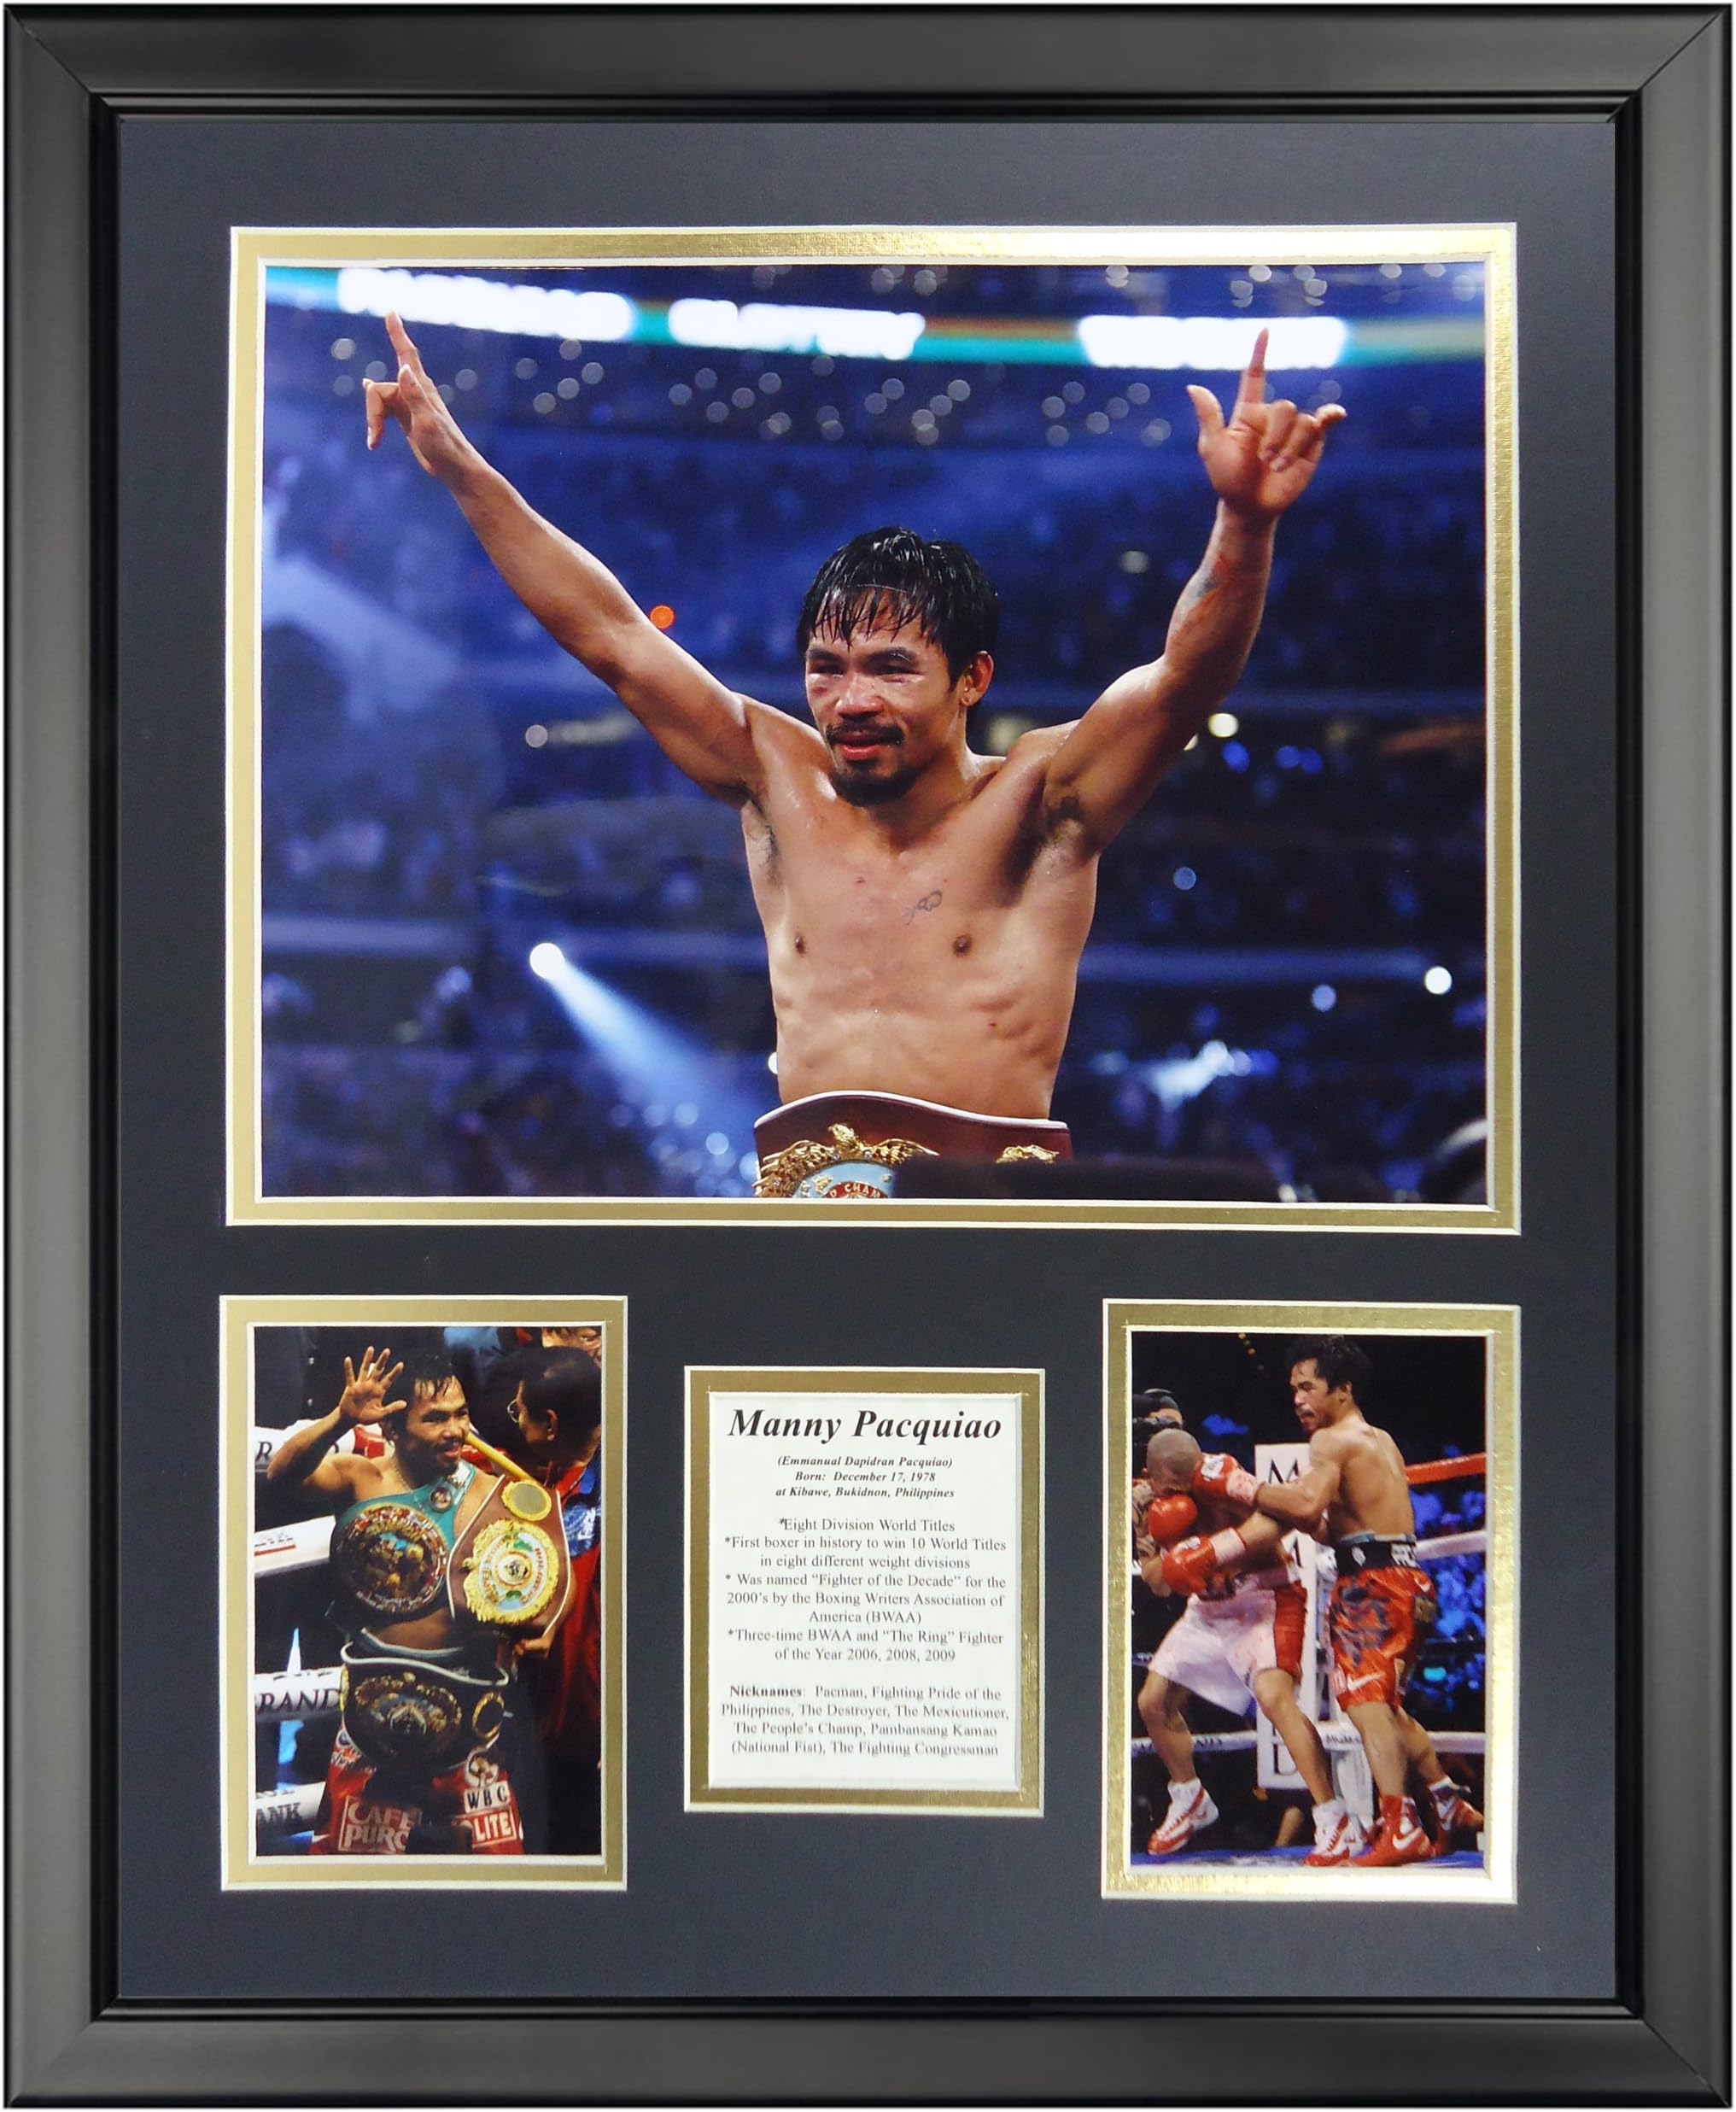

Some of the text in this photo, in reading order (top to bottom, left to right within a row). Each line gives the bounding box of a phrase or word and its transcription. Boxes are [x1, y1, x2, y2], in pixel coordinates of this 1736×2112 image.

[727, 1408, 1002, 1447] Manny Pacquiao
[777, 1455, 953, 1469] (Emmanual Dapidran Pacquiao)
[794, 1471, 936, 1483] Born: December 17, 1978
[788, 1486, 832, 1497] Kibawe,
[834, 1487, 891, 1497] Bukidnon,
[894, 1488, 956, 1500] Philippines
[821, 1518, 874, 1530] Division
[879, 1518, 916, 1530] World
[920, 1519, 956, 1531] Titles
[764, 1536, 800, 1547] boxer
[804, 1536, 815, 1548] in
[820, 1536, 862, 1551] history
[867, 1539, 879, 1548] to
[883, 1537, 906, 1548] win
[912, 1538, 926, 1549] 10
[930, 1537, 968, 1550] World
[971, 1539, 1007, 1550] Titles
[760, 1554, 971, 1571] in eight different weight divisions
[737, 1573, 763, 1585] Was
[766, 1573, 808, 1585] named
[867, 1574, 882, 1586] of
[884, 1574, 903, 1586] the
[965, 1576, 984, 1588] for
[987, 1577, 1006, 1588] the
[772, 1592, 788, 1606] by
[792, 1592, 811, 1603] the
[815, 1592, 861, 1606] Boxing
[865, 1593, 910, 1605] Writers
[913, 1594, 986, 1606] Association
[990, 1595, 1005, 1606] of
[809, 1611, 922, 1624] America (BWAA)
[808, 1629, 852, 1641] BWAA
[856, 1629, 879, 1641] and
[959, 1631, 1004, 1646] Fighter
[774, 1647, 956, 1662] of the Year 2006, 2008, 2009
[729, 1685, 1002, 1700] Nicknames: Pacman, Fighting Pride of the
[722, 1703, 1009, 1719] Philippines, The Destroyer, The Mexicutioner,
[733, 1722, 757, 1734] The
[817, 1722, 866, 1737] Champ,
[871, 1723, 949, 1737] Pambansang
[953, 1724, 997, 1736] Kamao
[731, 1740, 998, 1758] (National Fist), The Fighting Congressman
[466, 1785, 508, 1810] WBC
[462, 1811, 512, 1842] LITE
